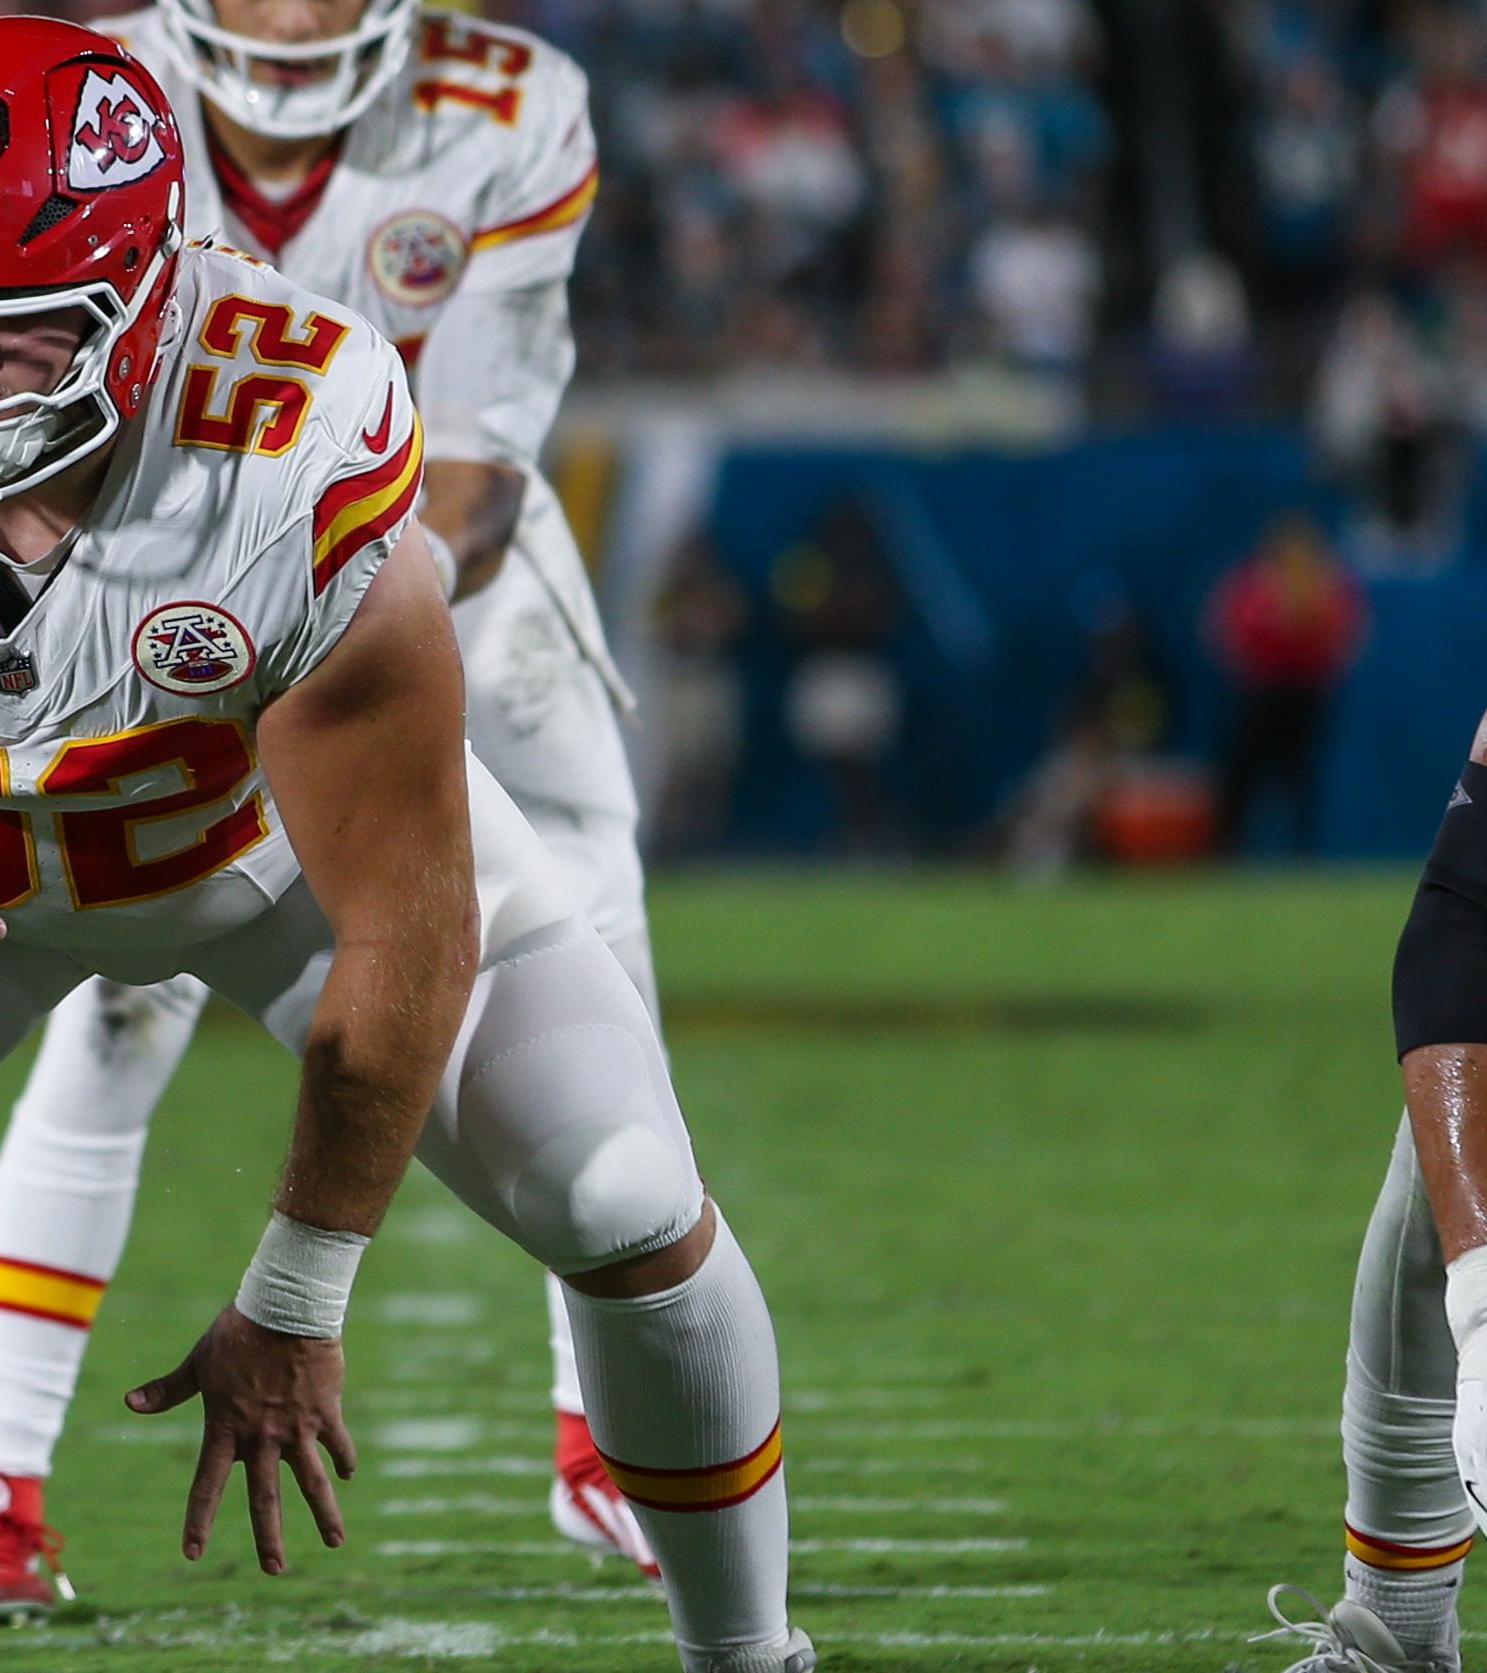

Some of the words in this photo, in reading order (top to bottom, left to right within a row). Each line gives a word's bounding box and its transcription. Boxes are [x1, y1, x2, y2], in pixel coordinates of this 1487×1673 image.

[415, 15, 535, 129] 15
[174, 292, 352, 458] 52
[0, 668, 34, 691] NFL
